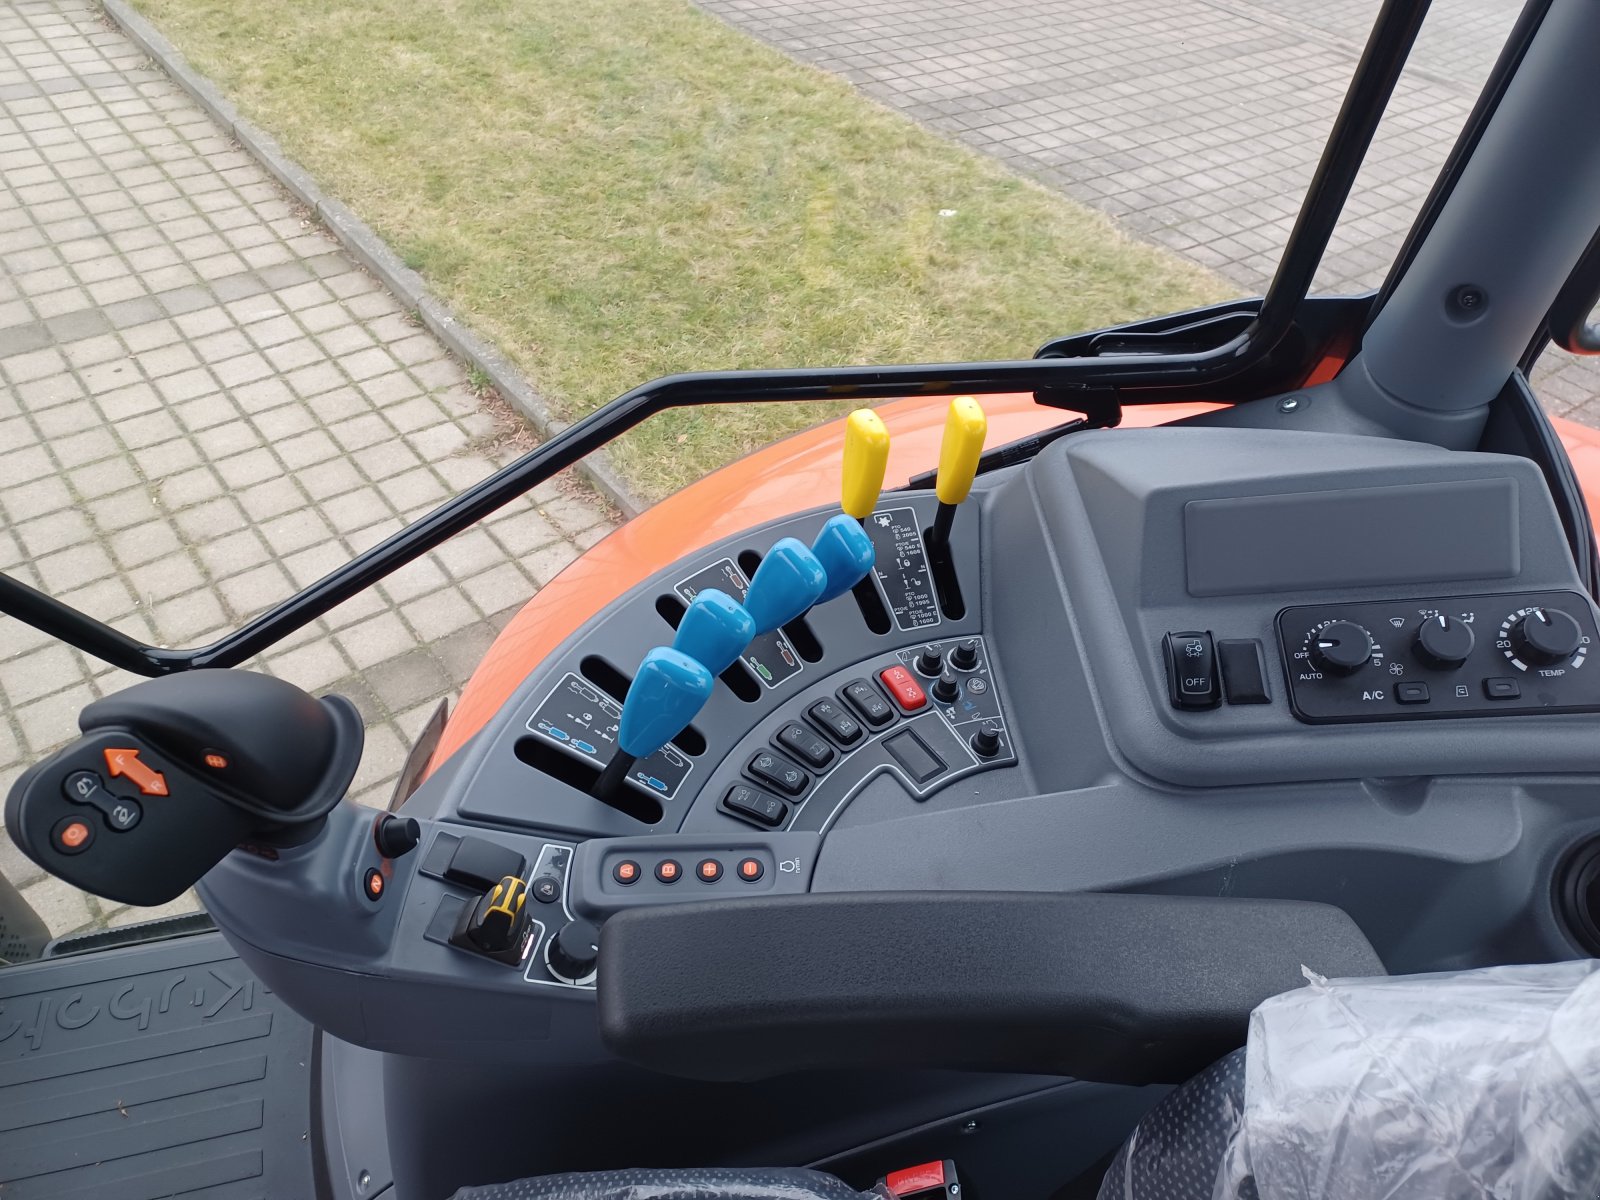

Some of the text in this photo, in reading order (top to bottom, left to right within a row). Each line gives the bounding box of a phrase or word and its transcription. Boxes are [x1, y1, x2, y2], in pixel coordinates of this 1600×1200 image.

[1496, 640, 1511, 648] 20
[1373, 659, 1381, 667] 5
[1299, 672, 1323, 681] AUTO
[1539, 669, 1565, 677] TEMP
[1186, 678, 1205, 686] OFF
[1362, 690, 1384, 701] A/C
[115, 754, 125, 766] F
[150, 780, 161, 791] R
